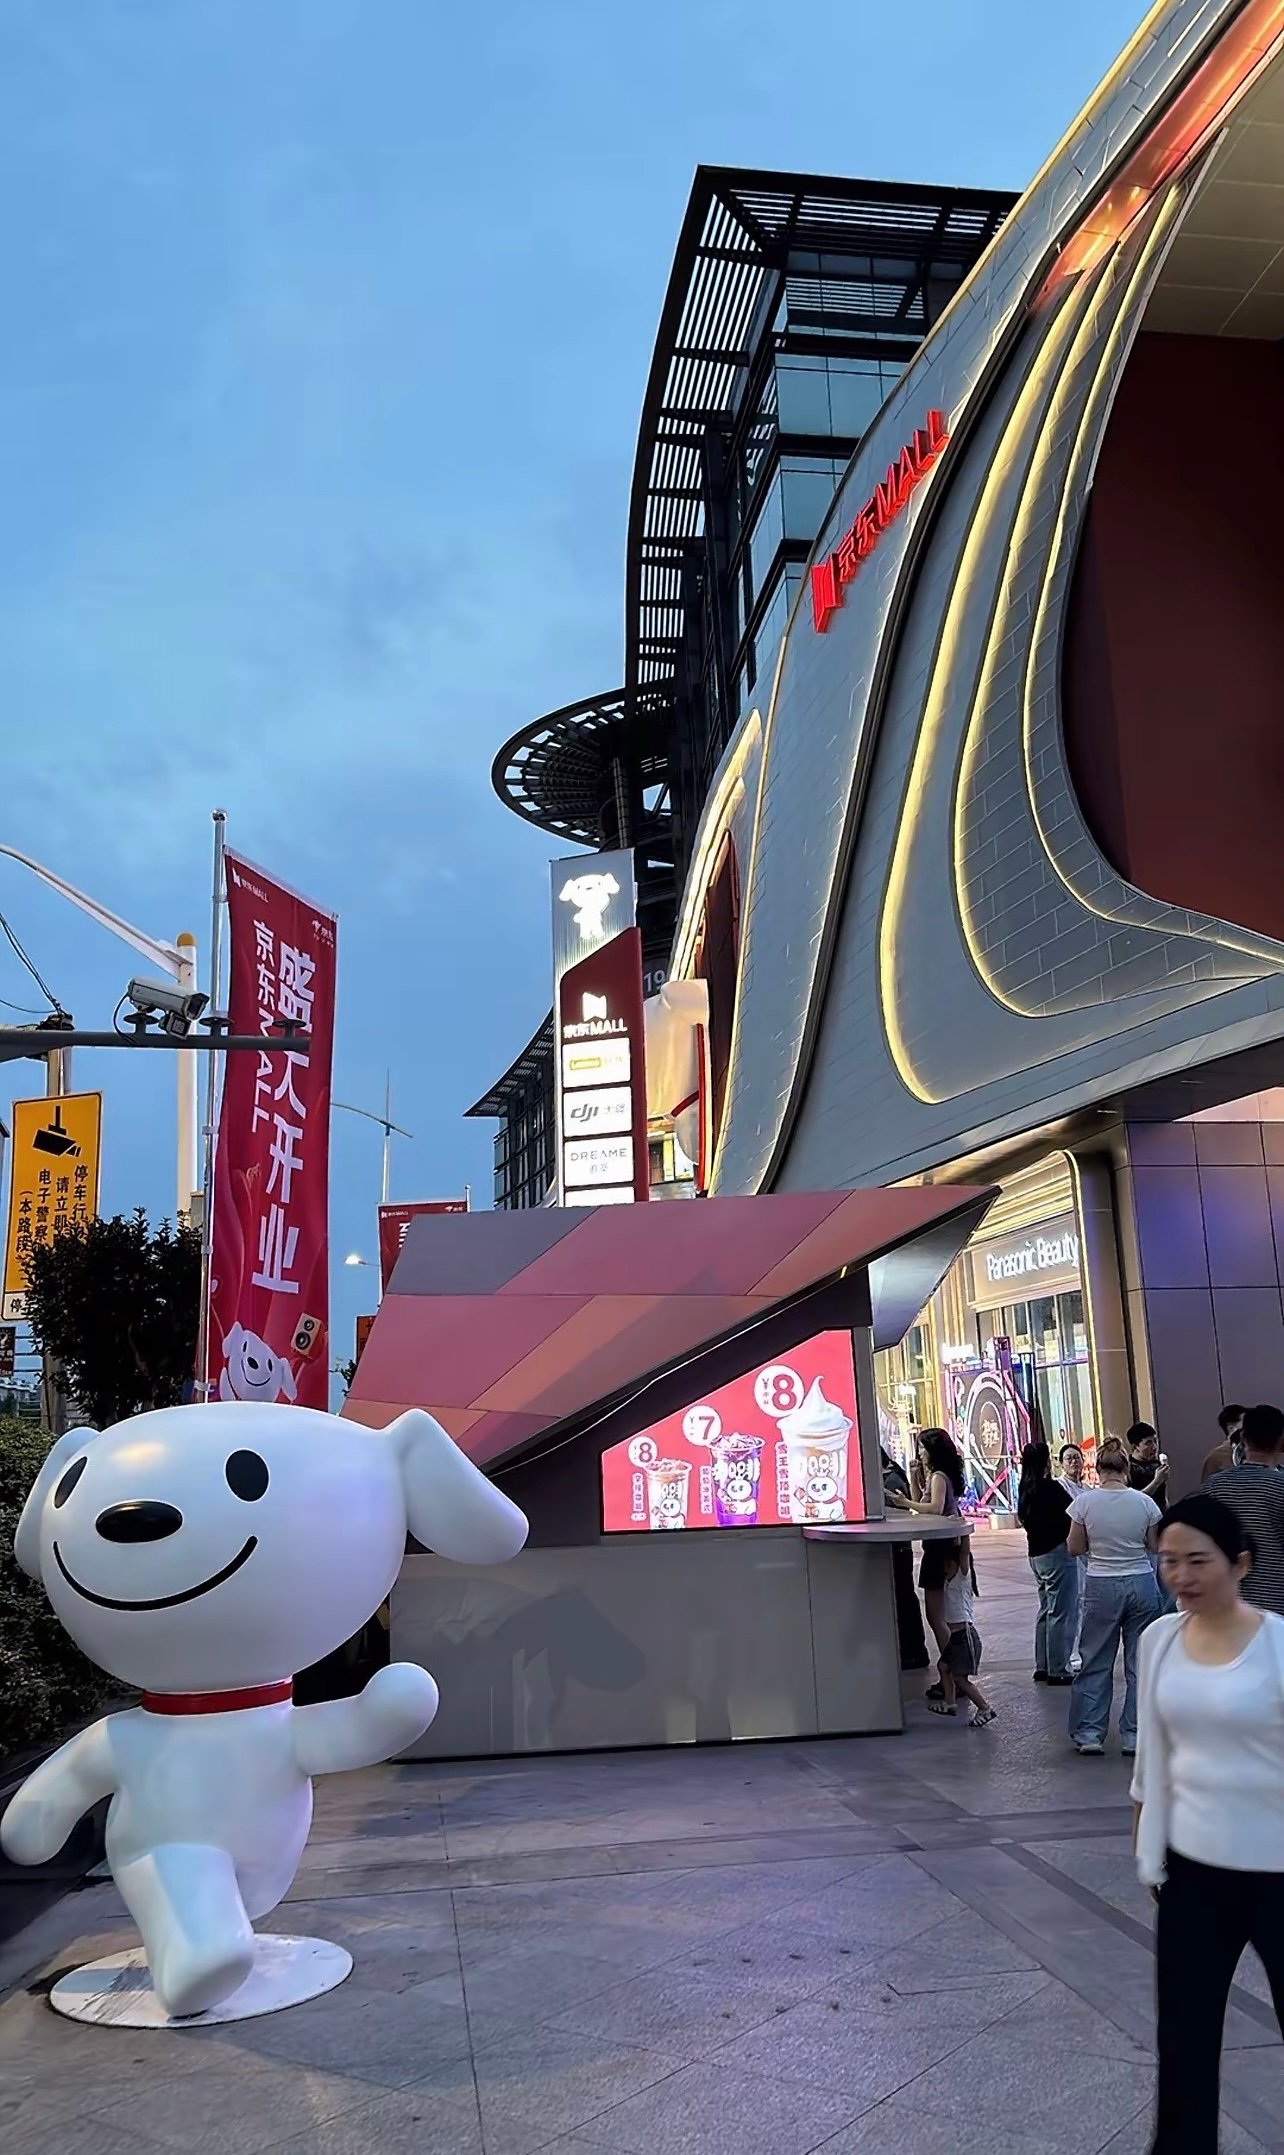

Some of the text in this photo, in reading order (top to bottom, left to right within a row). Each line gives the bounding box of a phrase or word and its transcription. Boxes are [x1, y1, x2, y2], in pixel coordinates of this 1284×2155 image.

[837, 410, 950, 583] 京东MALL
[252, 941, 316, 1294] 盛大开业
[986, 1231, 1079, 1281] Panasonic Beauty
